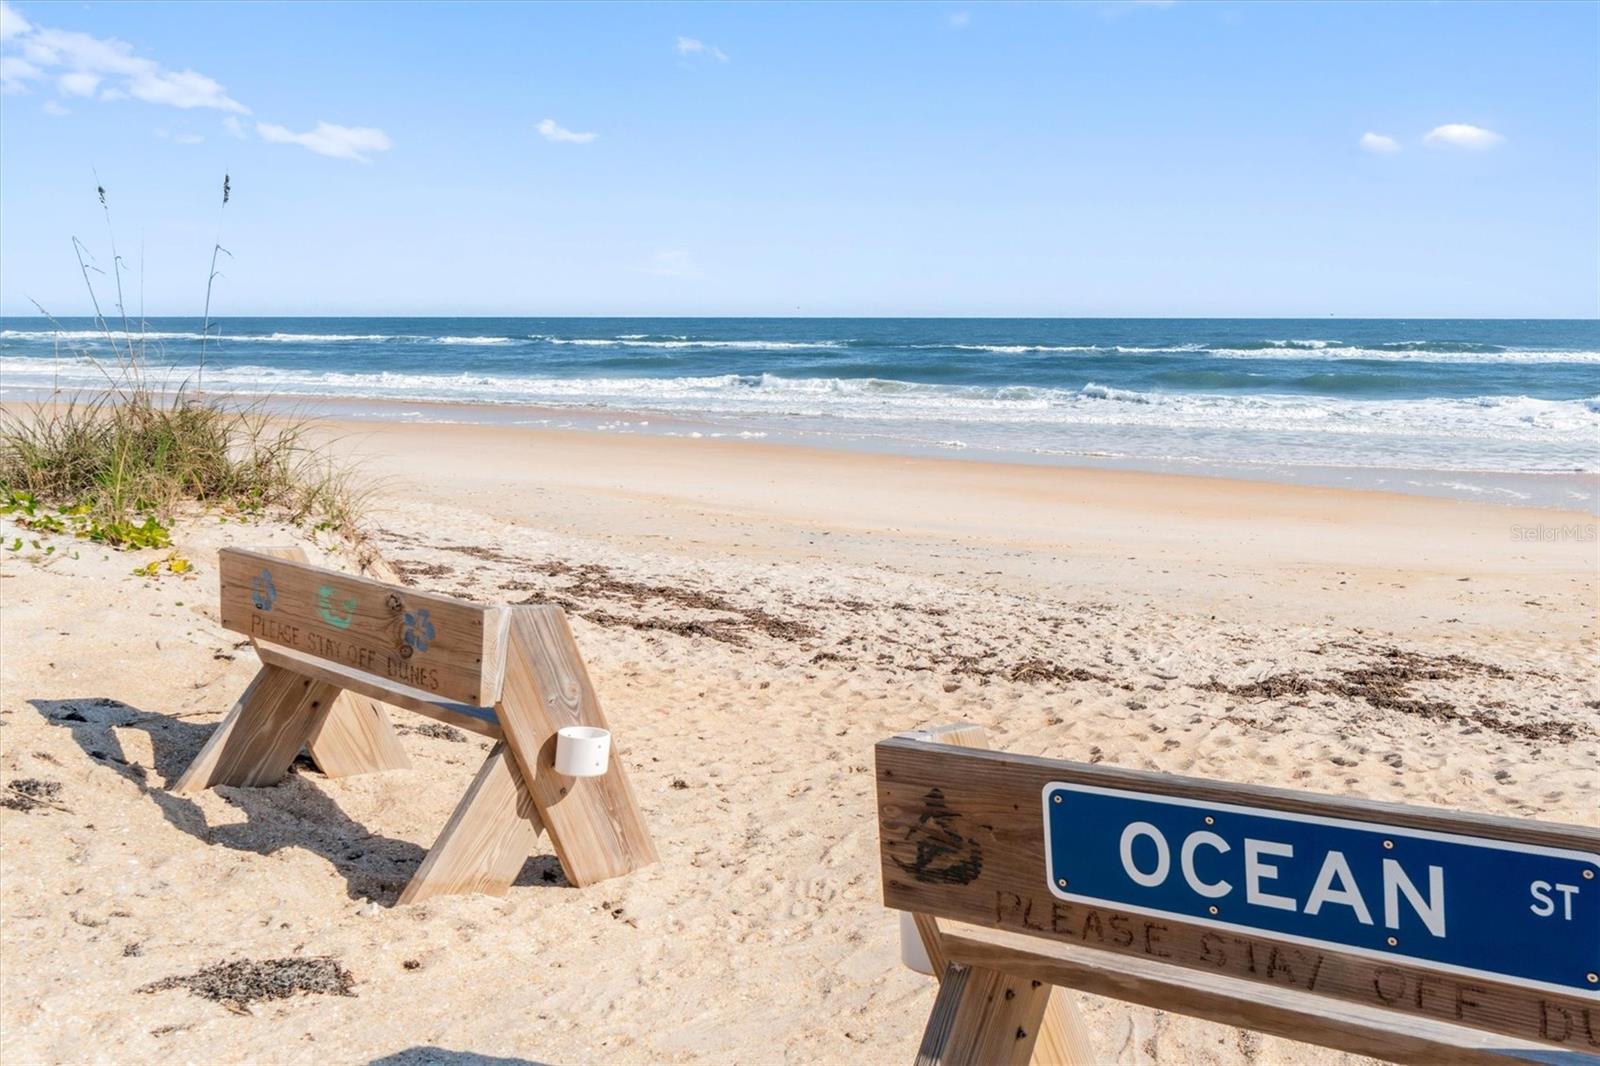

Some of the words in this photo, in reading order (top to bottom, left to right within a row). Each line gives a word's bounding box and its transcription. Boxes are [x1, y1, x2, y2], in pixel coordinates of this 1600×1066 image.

[250, 613, 300, 646] PLEASE
[307, 631, 342, 658] STAY
[347, 645, 376, 669] OFF
[387, 656, 439, 690] DUNES
[1120, 821, 1446, 938] OCEAN
[1529, 880, 1580, 920] ST
[996, 890, 1171, 958] PLEASE
[1200, 932, 1324, 991] STAY
[1374, 965, 1487, 1019] OFF
